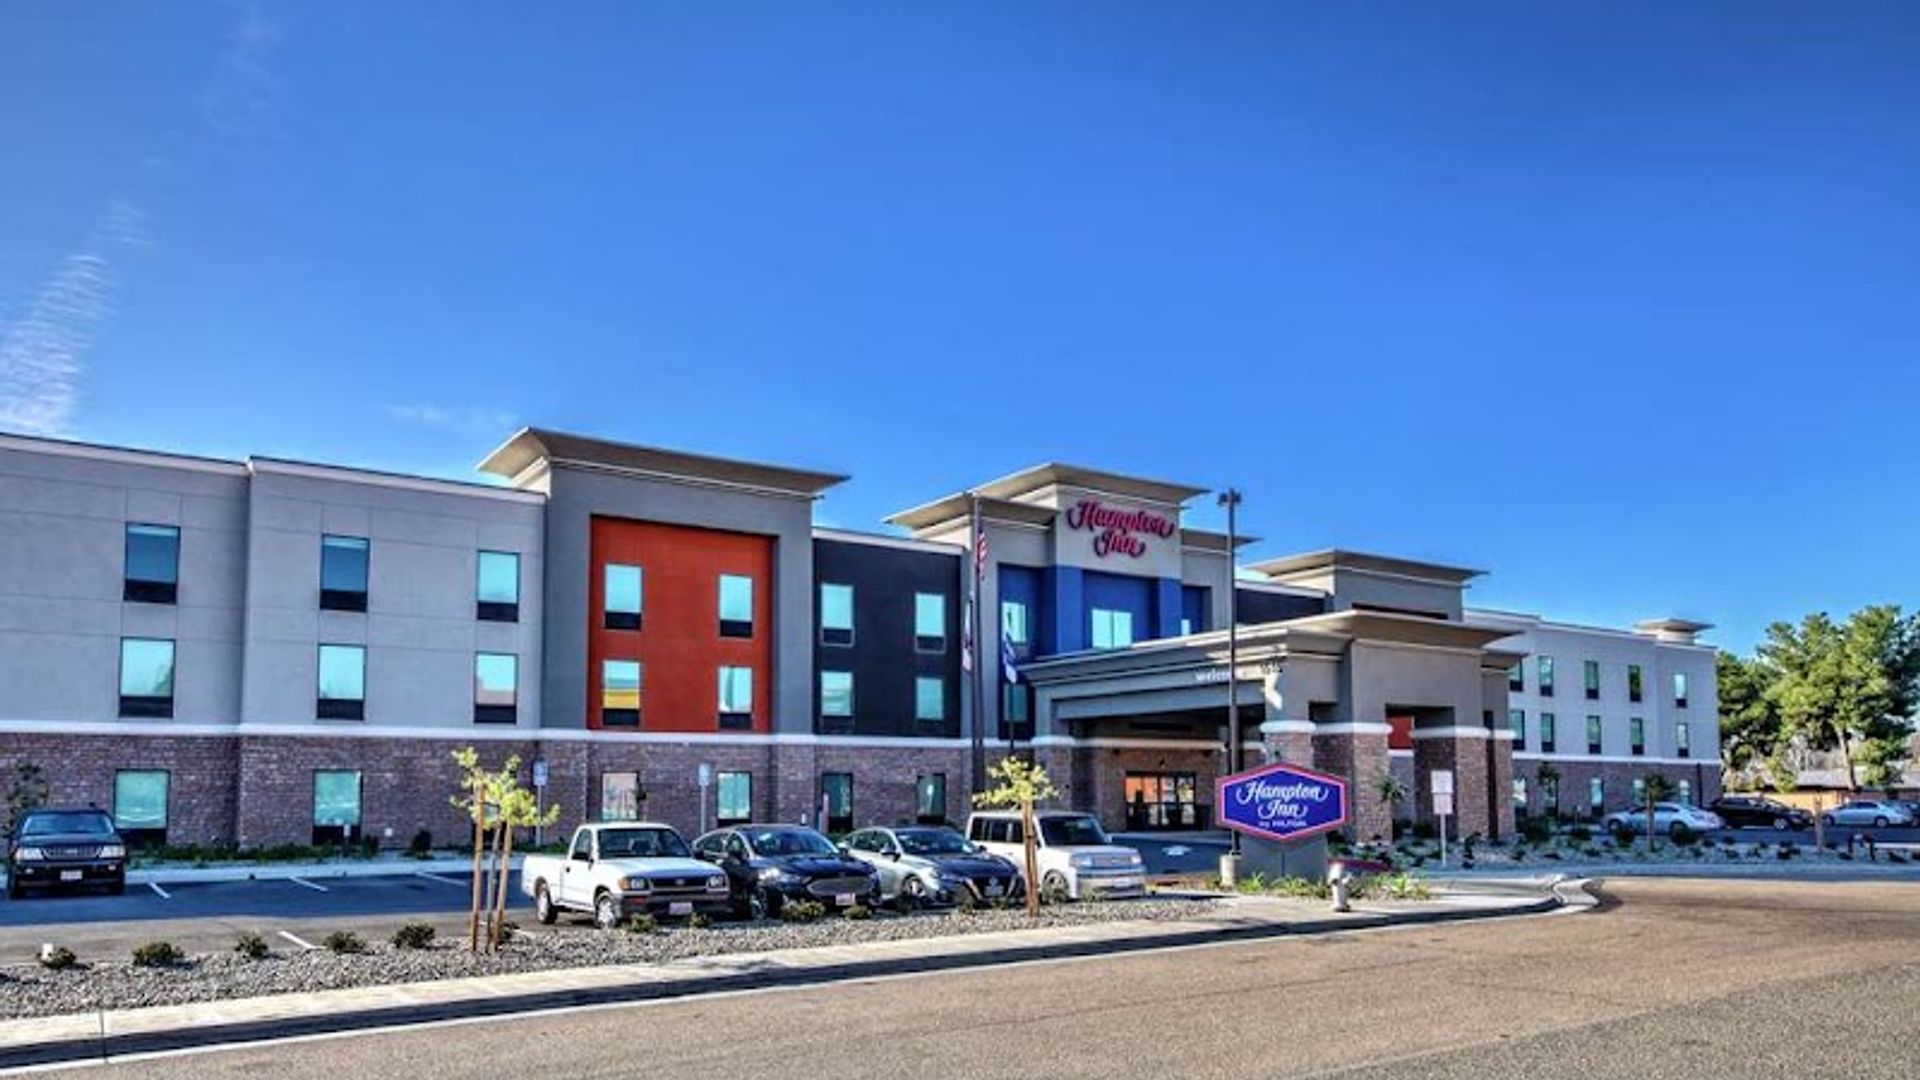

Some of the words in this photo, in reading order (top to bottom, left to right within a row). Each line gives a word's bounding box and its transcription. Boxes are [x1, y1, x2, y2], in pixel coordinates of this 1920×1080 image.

[1067, 501, 1175, 538] Hampton
[1094, 530, 1146, 558] Inn
[1236, 780, 1329, 805] Hampton
[1257, 800, 1309, 819] Inn
